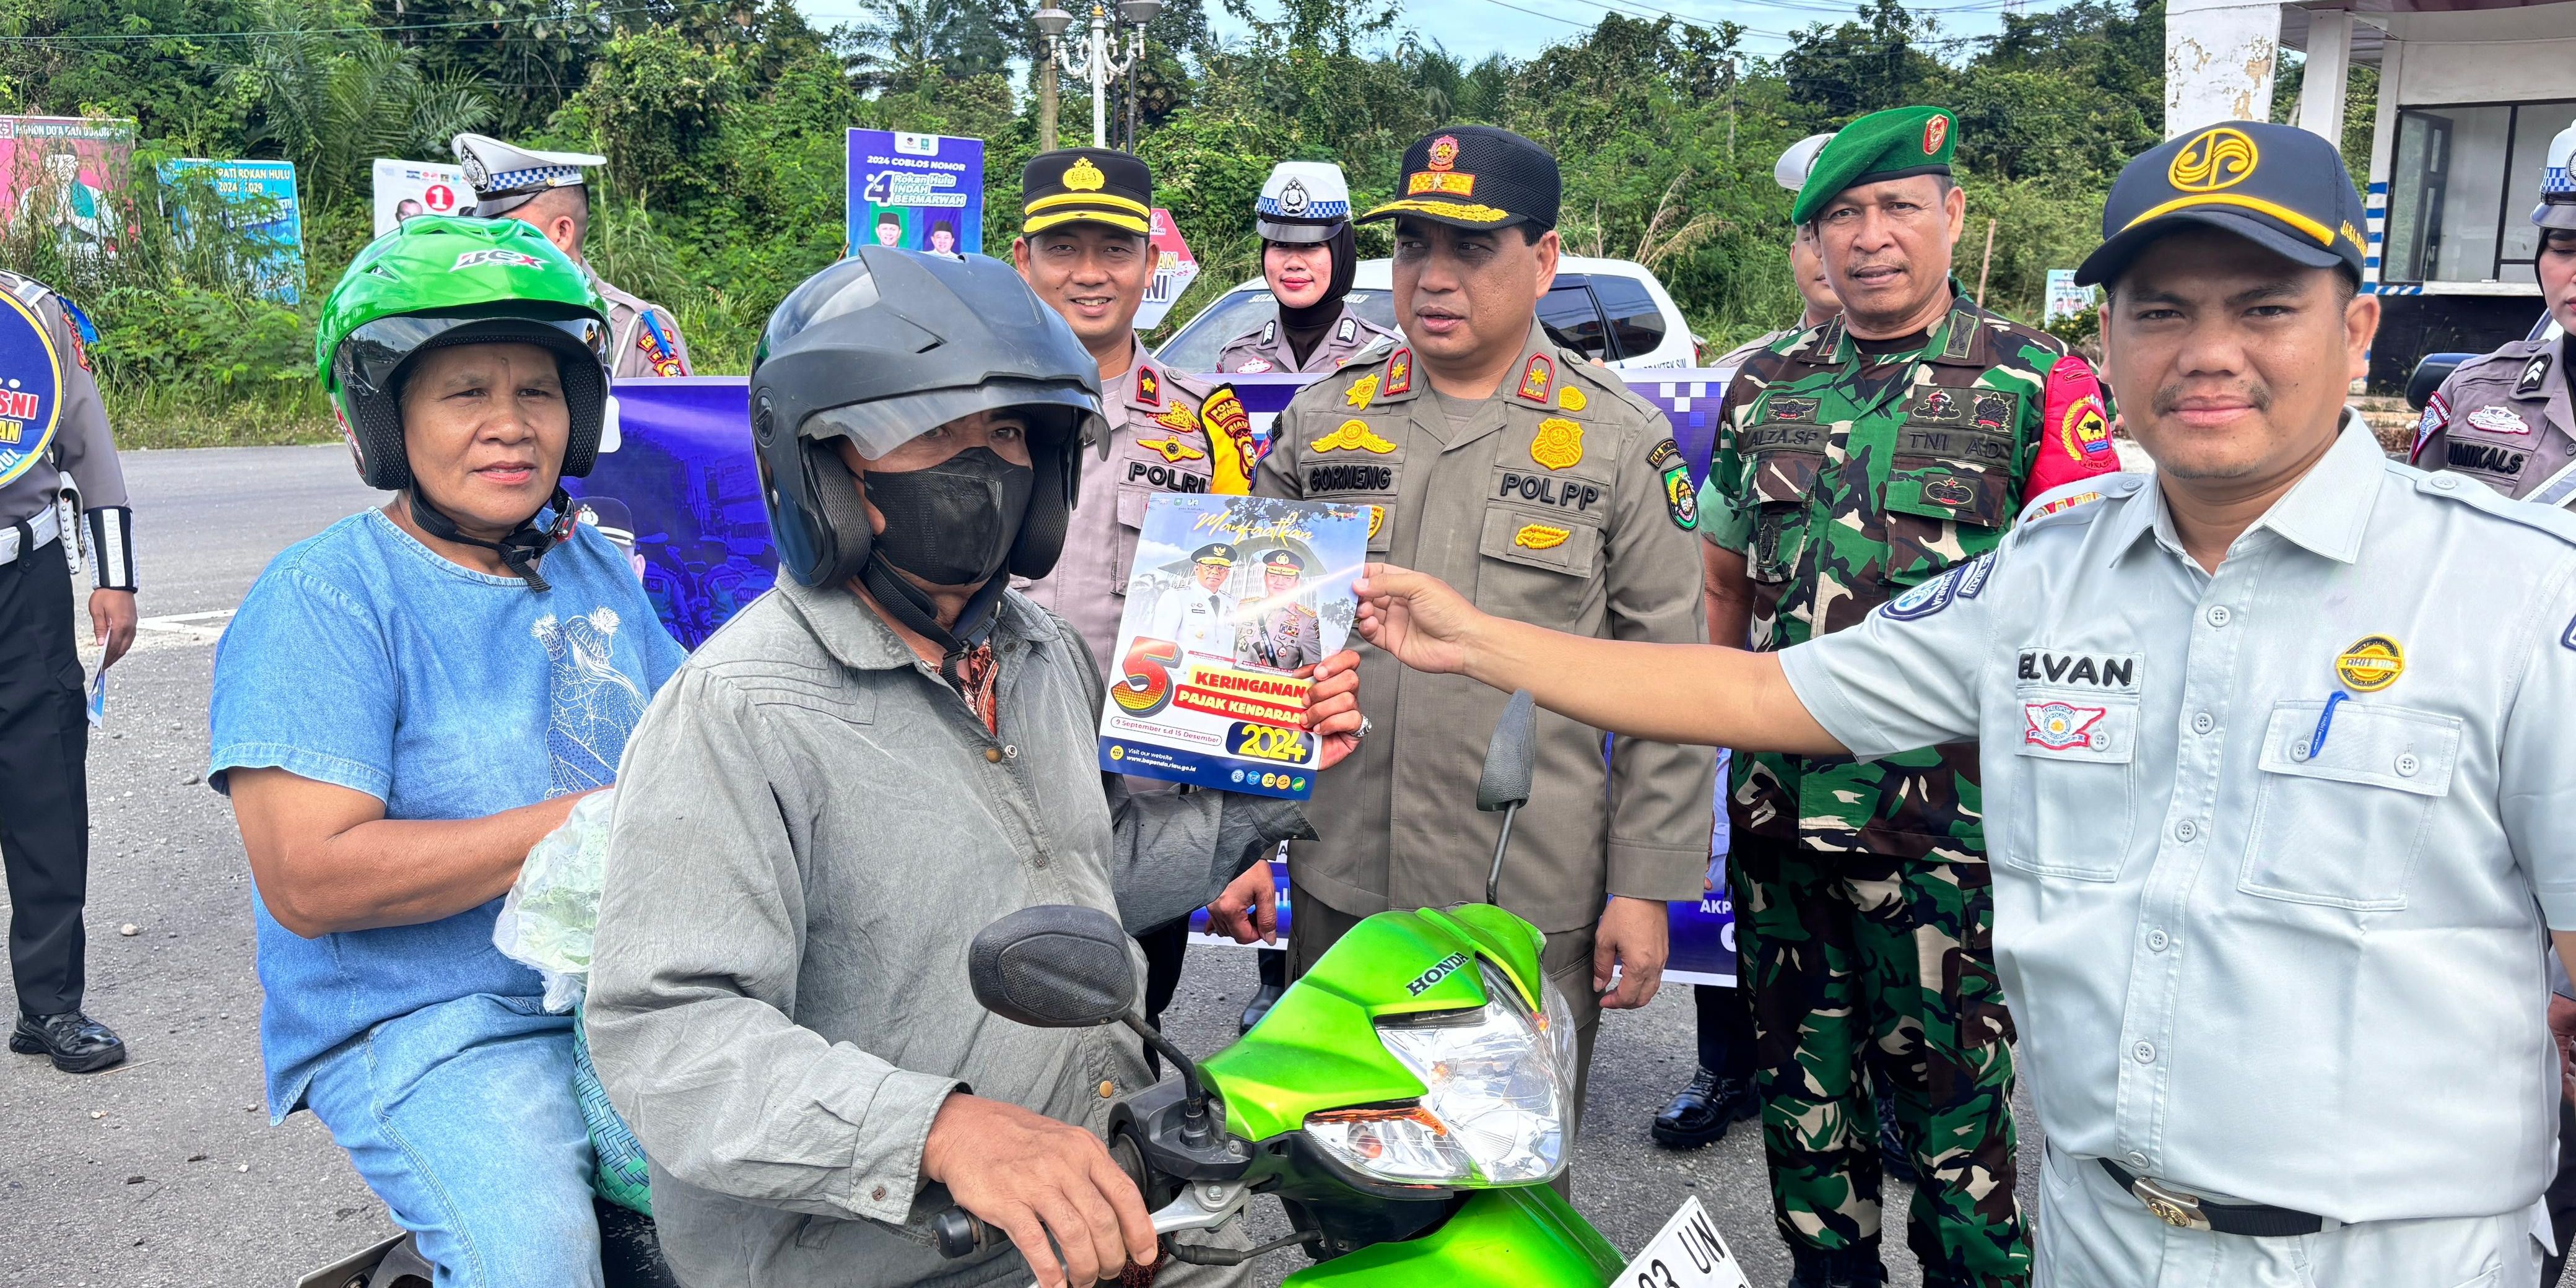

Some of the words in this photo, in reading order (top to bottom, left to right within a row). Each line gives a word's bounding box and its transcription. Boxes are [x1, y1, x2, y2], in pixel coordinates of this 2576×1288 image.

[46, 126, 63, 135] DO'A
[238, 168, 266, 179] ROKAN
[268, 169, 290, 180] HULU
[867, 156, 890, 165] 2024
[891, 159, 929, 168] COBLOS
[930, 162, 966, 172] NOMOR
[218, 181, 238, 192] 2024
[894, 174, 927, 184] Rokan
[930, 175, 954, 185] Hulu
[894, 185, 929, 194] INDAH
[432, 187, 447, 209] 1
[894, 194, 965, 205] BERMARWAH
[1228, 420, 1248, 433] RIAU
[1908, 432, 1951, 451] TNI
[1965, 438, 2002, 459] AD
[1128, 461, 1207, 494] POLRI
[1310, 464, 1391, 492] GORNENG
[1500, 473, 1556, 505] POL
[1559, 482, 1599, 511] PP
[1111, 636, 1180, 715] 5
[2018, 652, 2133, 687] ELVAN
[1195, 671, 1307, 698] KERINGANAN
[1178, 690, 1227, 710] PAJAK
[1228, 700, 1300, 724] KENDARAA
[1122, 720, 1161, 733] September
[1183, 731, 1219, 743] Desember
[1238, 724, 1307, 762] 2024
[1126, 755, 1196, 772] www.bapenda.riau.go.id
[1151, 753, 1173, 761] website
[1700, 899, 1733, 915] AKP
[1406, 952, 1469, 996] HONDA
[1677, 1211, 1725, 1274] UN
